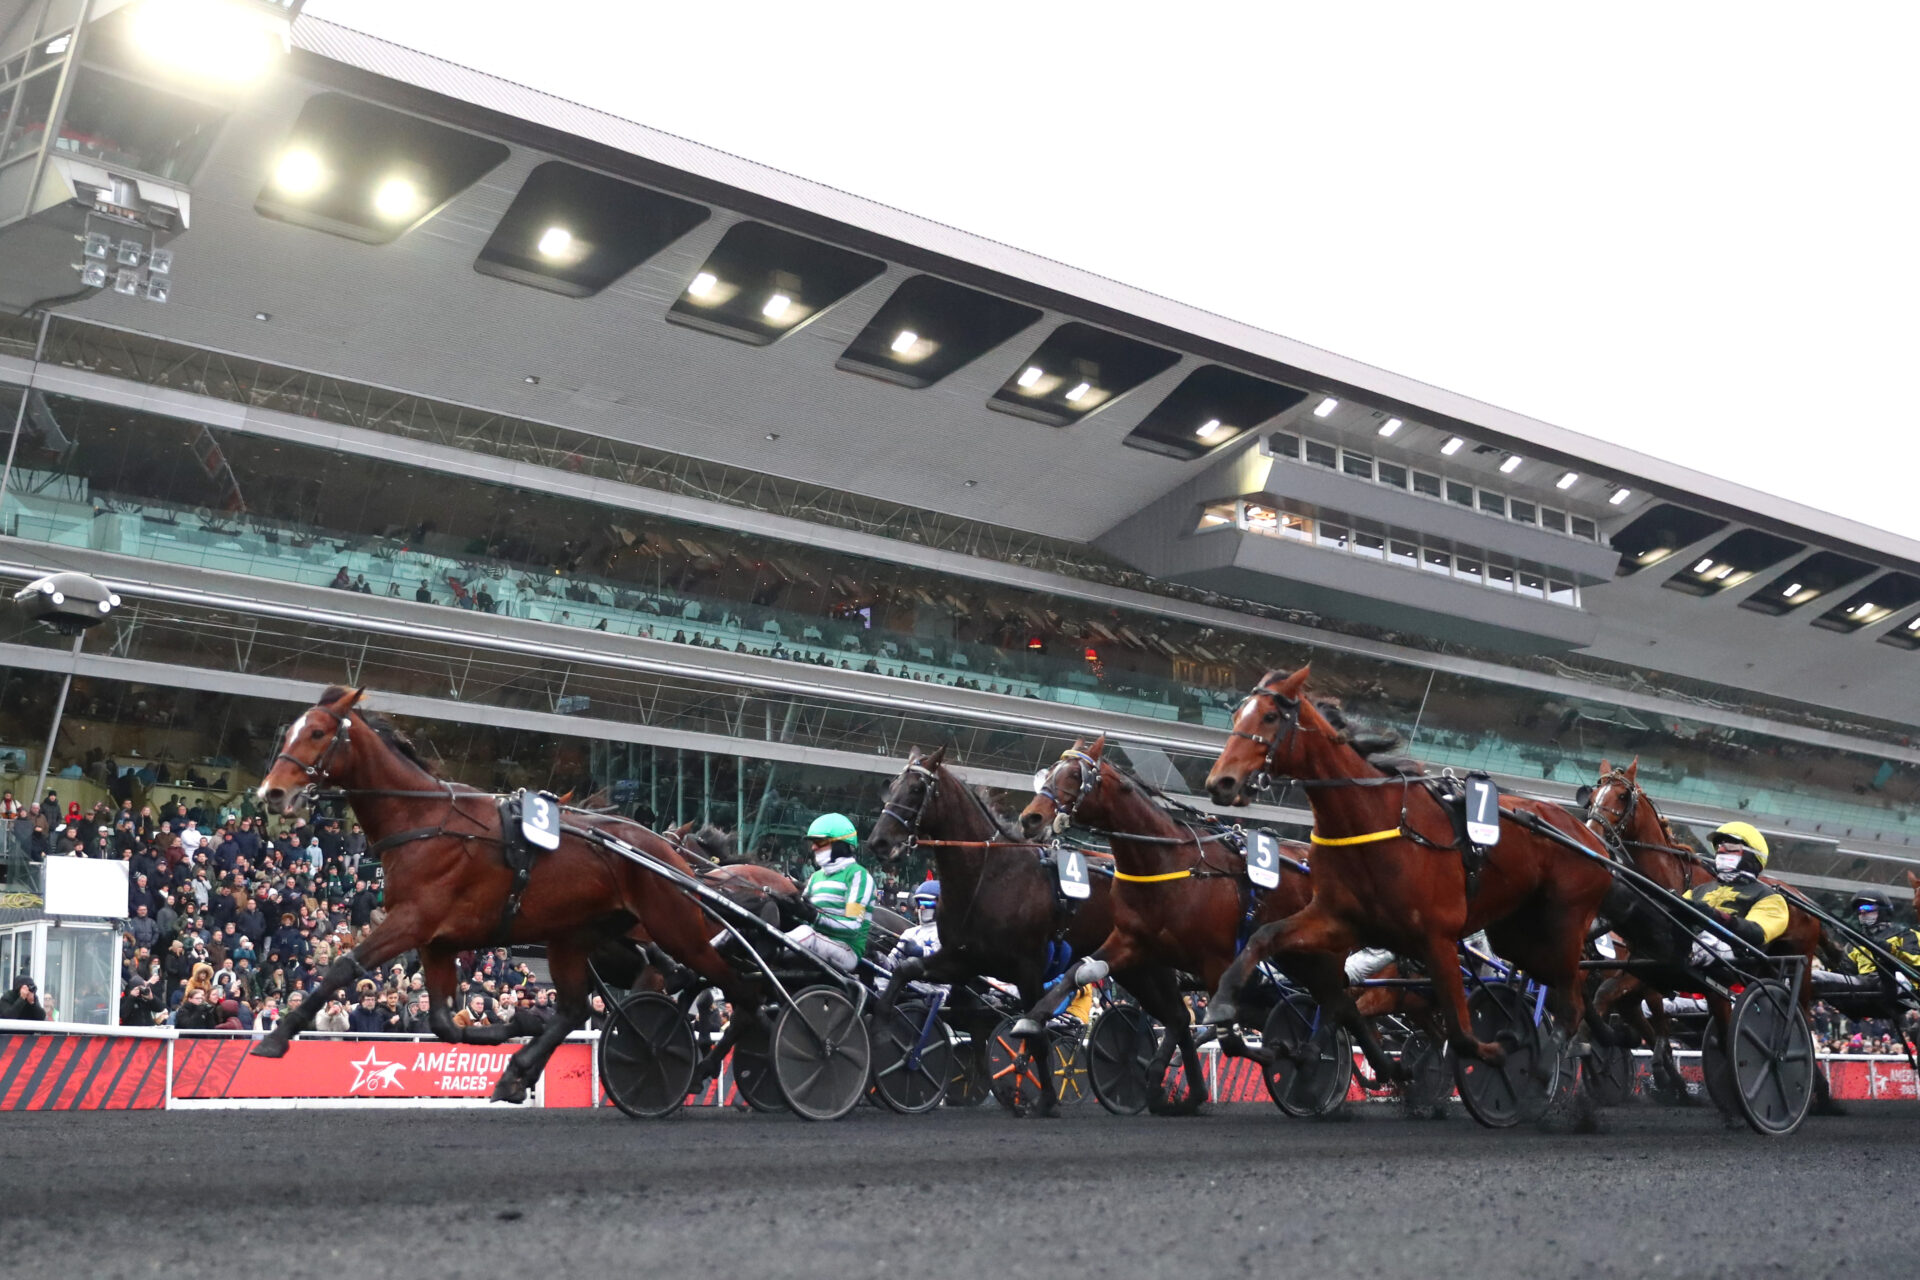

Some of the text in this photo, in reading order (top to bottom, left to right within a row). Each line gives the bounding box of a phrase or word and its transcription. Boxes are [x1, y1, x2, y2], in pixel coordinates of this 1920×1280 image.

[532, 797, 549, 830] 3
[1474, 782, 1489, 822] 7
[1065, 852, 1081, 882] 4
[1256, 834, 1271, 868] 5
